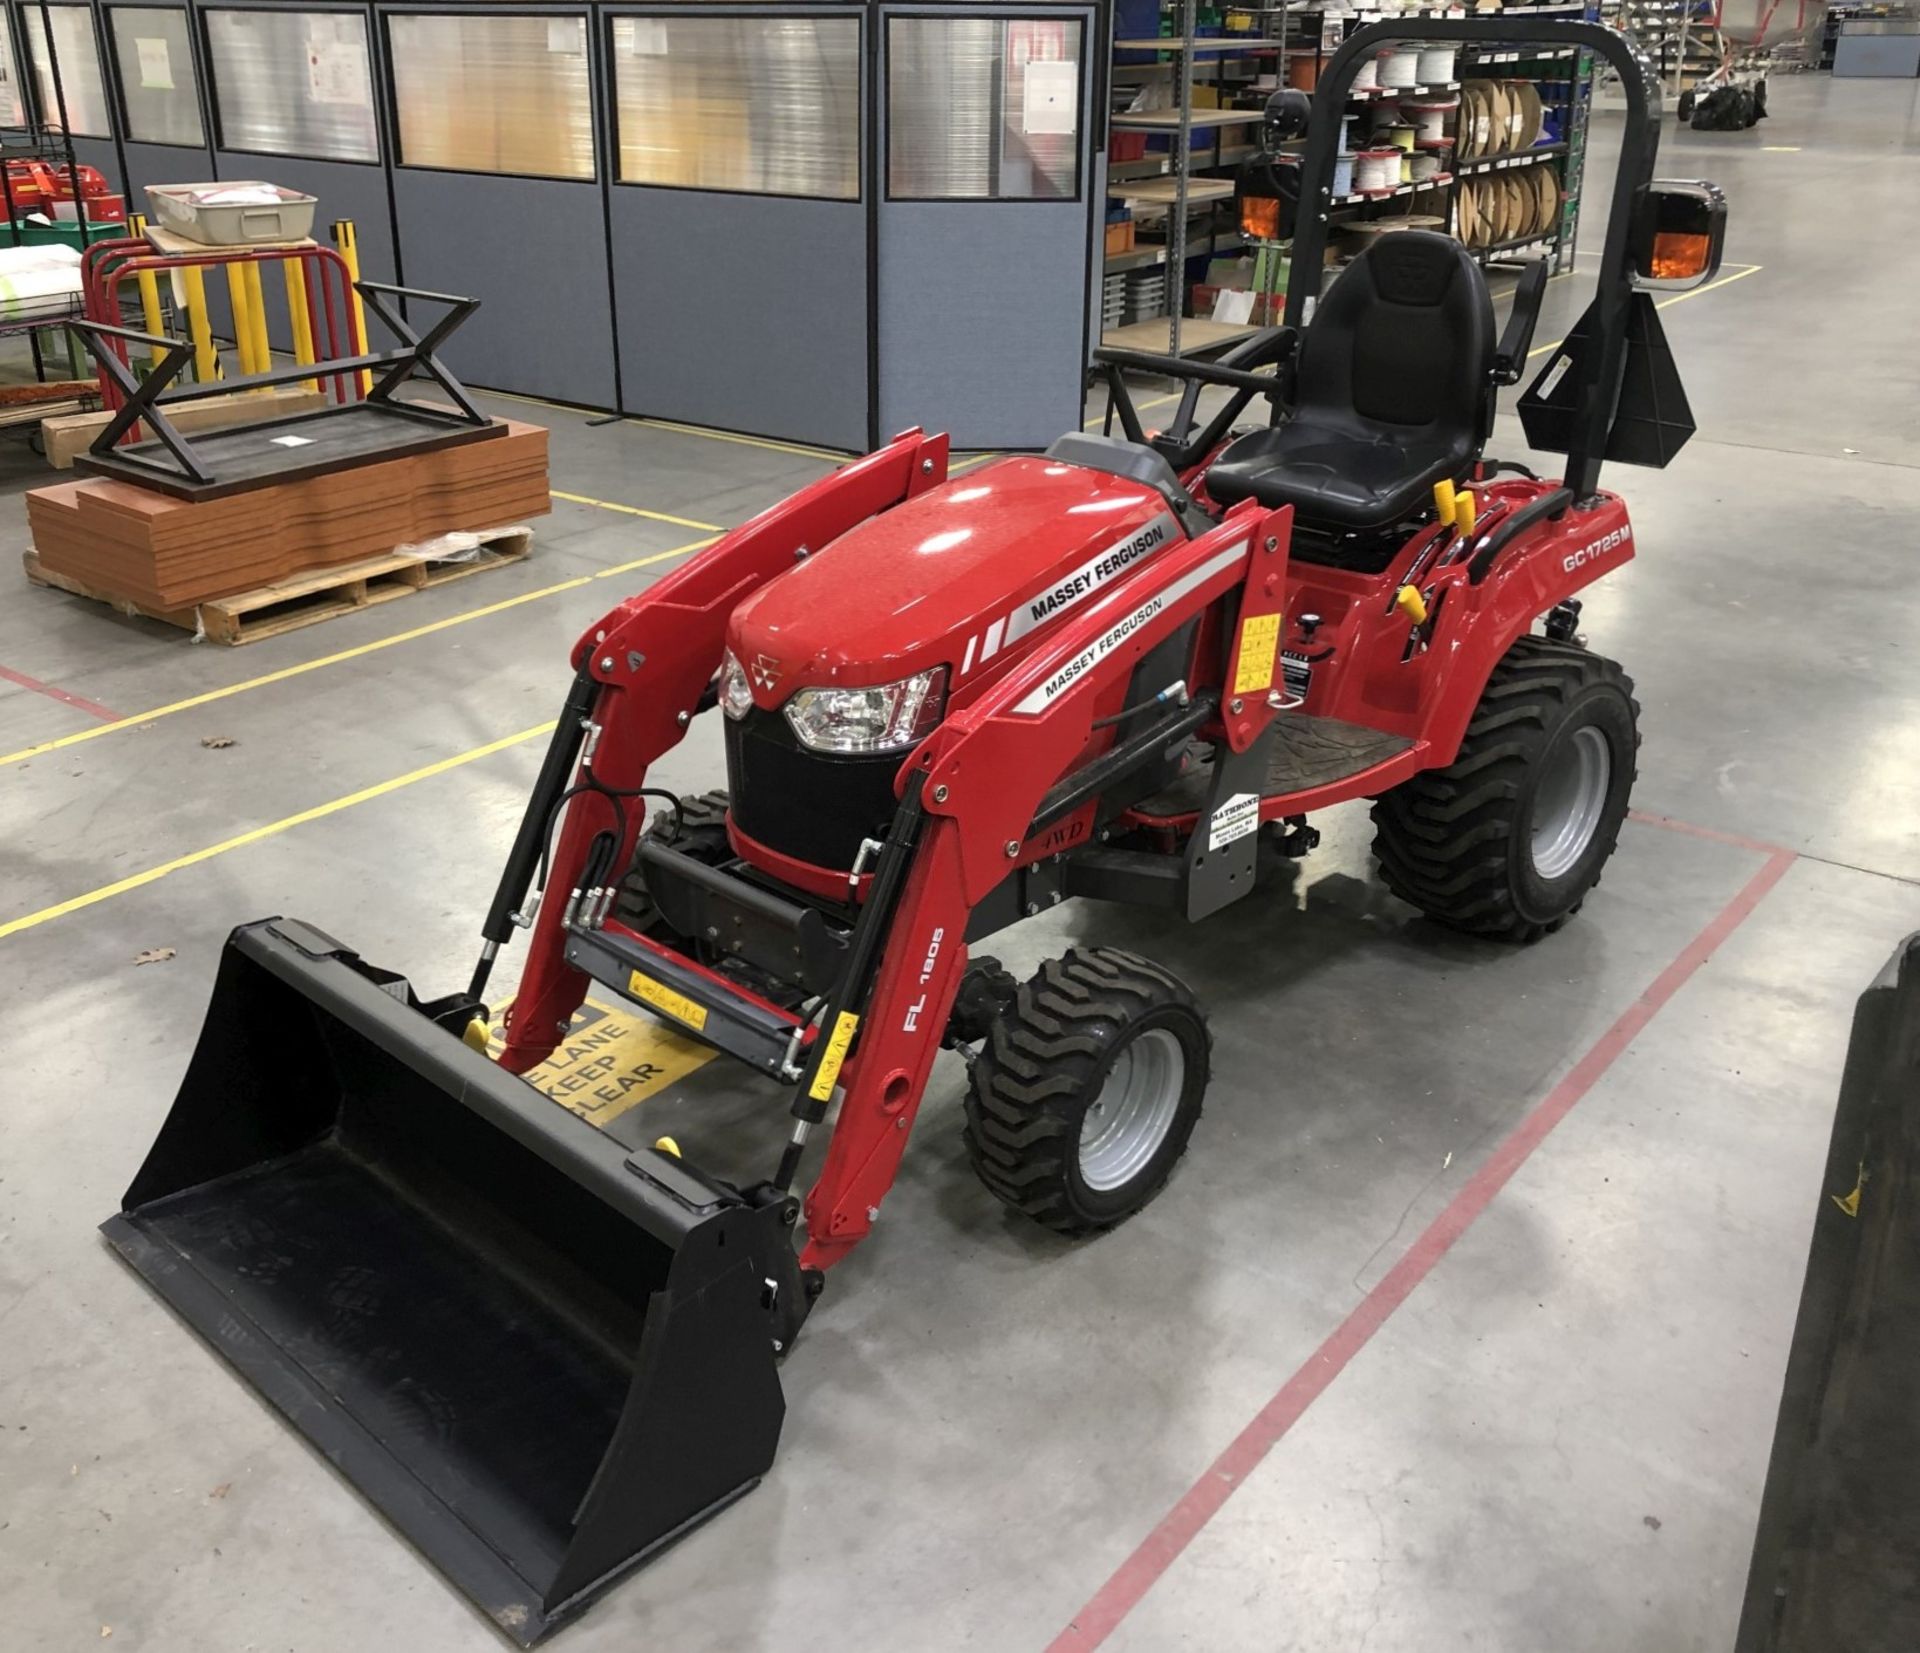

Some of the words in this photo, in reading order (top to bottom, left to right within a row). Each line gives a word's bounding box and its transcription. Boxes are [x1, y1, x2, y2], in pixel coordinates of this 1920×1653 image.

[1031, 571, 1092, 621] MASSEY
[1094, 525, 1164, 580] FERGUSON
[1563, 524, 1631, 573] GC1725M
[1045, 648, 1096, 698] MASSEY
[1099, 597, 1163, 653] FERGUSON
[902, 994, 926, 1032] FL
[920, 927, 944, 985] 1805
[544, 1023, 629, 1069] LANE
[547, 1055, 616, 1097] KEEP
[569, 1063, 664, 1118] LEAR
